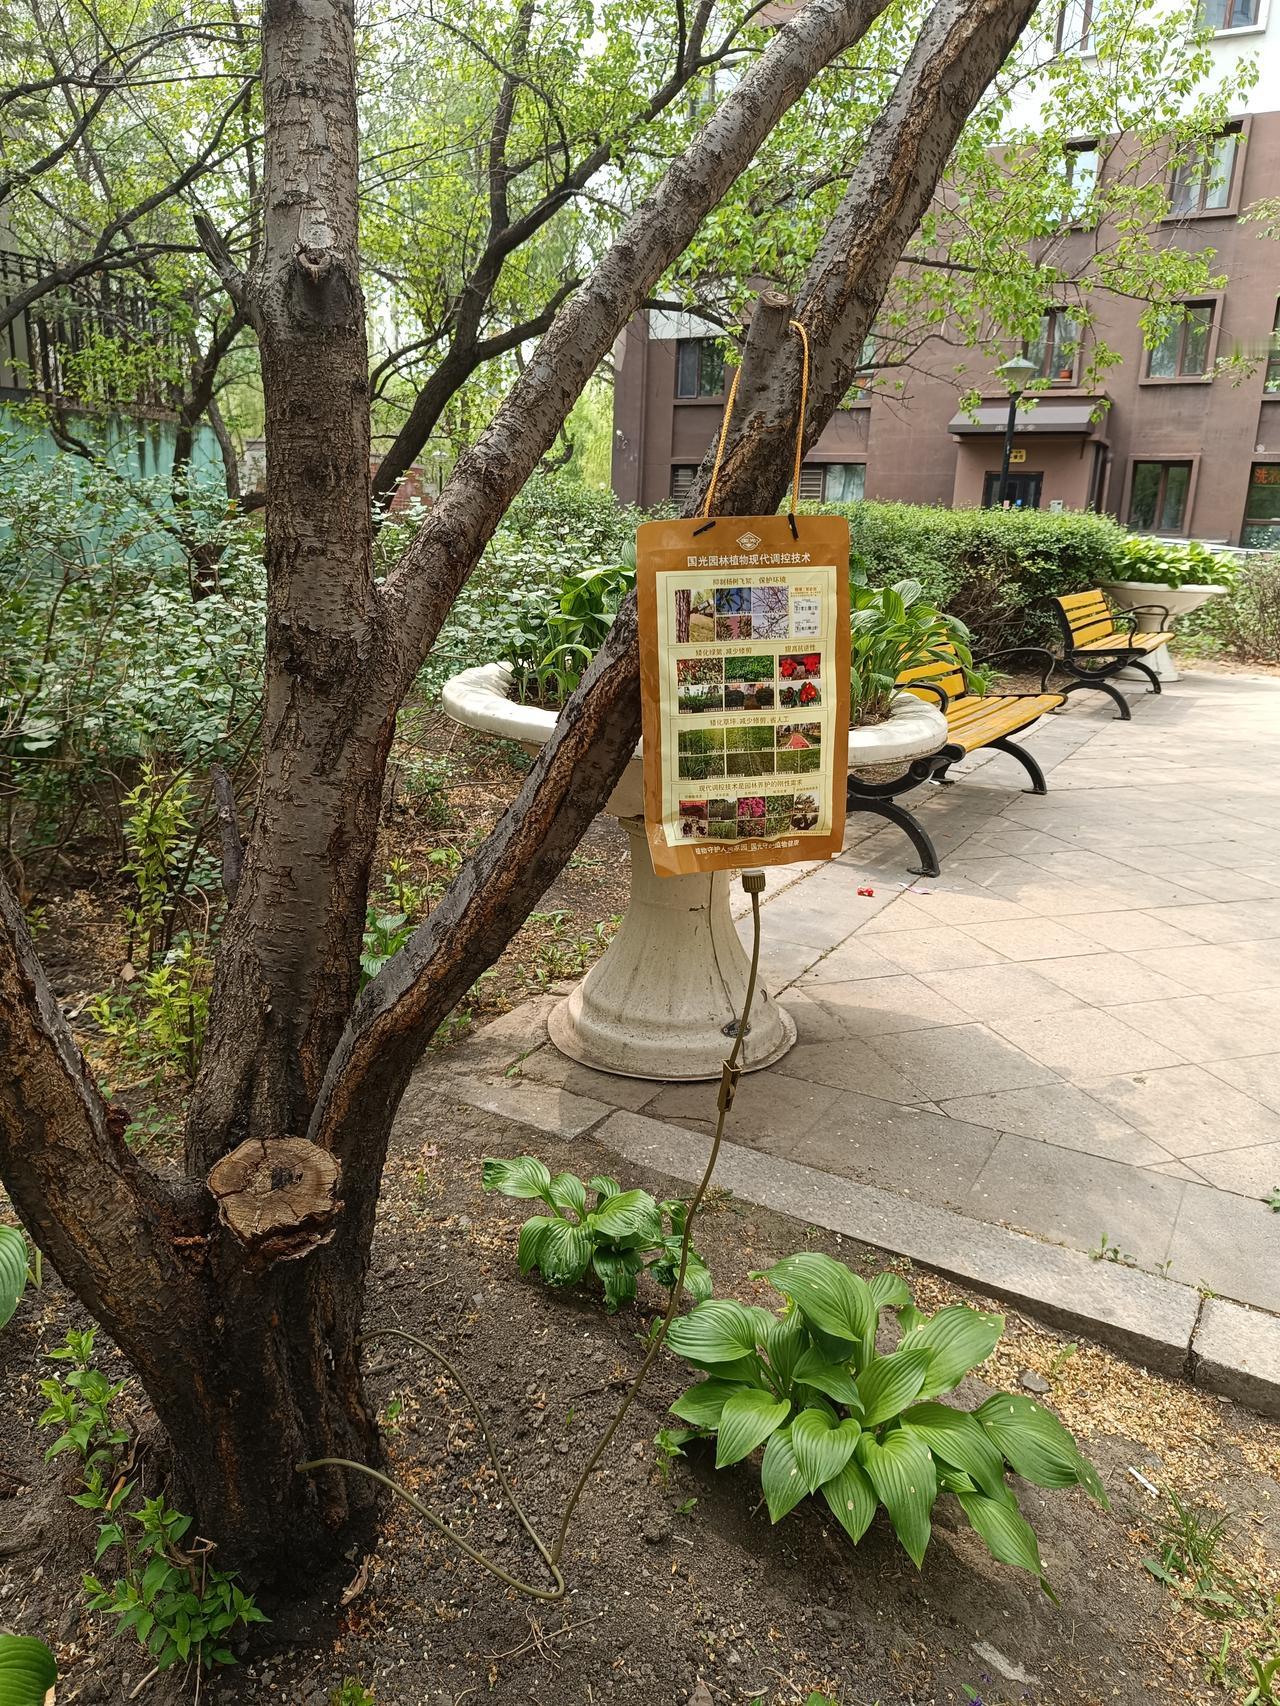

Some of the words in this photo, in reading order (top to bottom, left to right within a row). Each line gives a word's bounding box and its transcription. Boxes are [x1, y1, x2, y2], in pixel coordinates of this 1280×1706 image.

[687, 552, 811, 567] 国光园林植物现代调控技术
